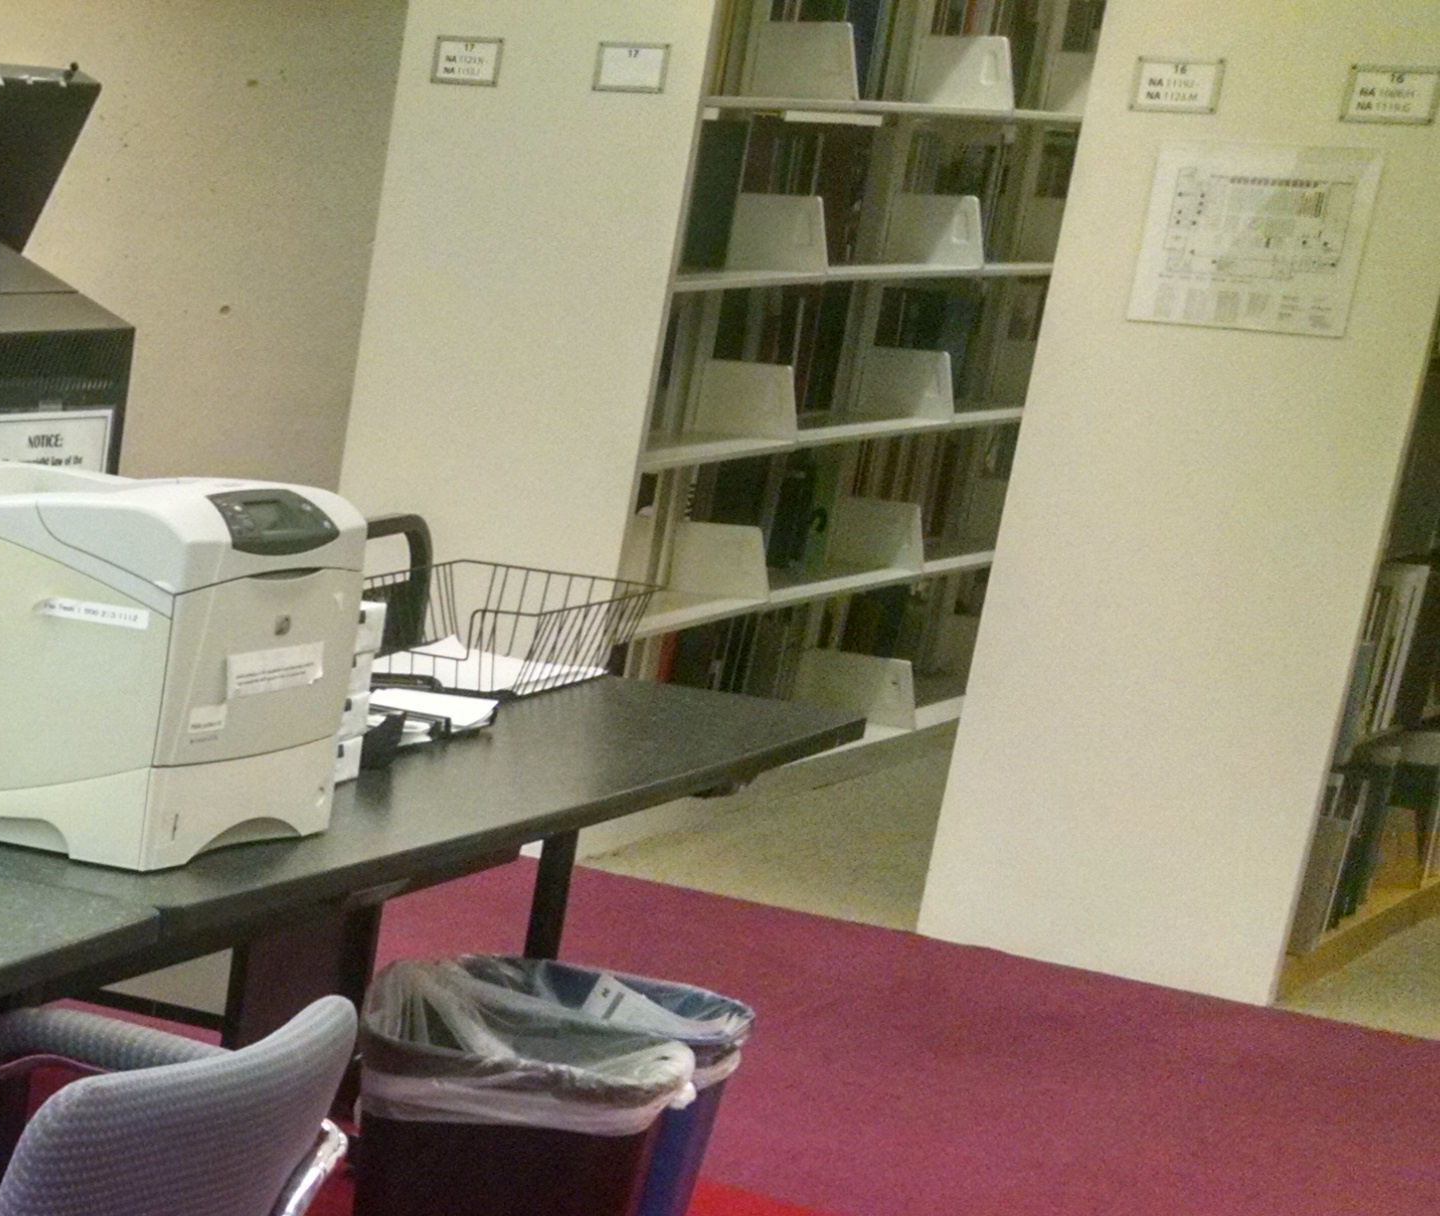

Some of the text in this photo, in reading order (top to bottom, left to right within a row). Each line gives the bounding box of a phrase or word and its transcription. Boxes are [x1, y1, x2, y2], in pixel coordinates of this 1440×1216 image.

[628, 49, 639, 58] 17
[445, 55, 457, 63] NA
[1175, 64, 1187, 74] 16
[1149, 78, 1163, 86] NA
[1391, 73, 1404, 83] 16
[1146, 91, 1160, 99] NA
[1360, 87, 1375, 97] NA
[1356, 102, 1372, 110] NA
[28, 434, 63, 448] NOTICE:
[73, 455, 83, 464] the
